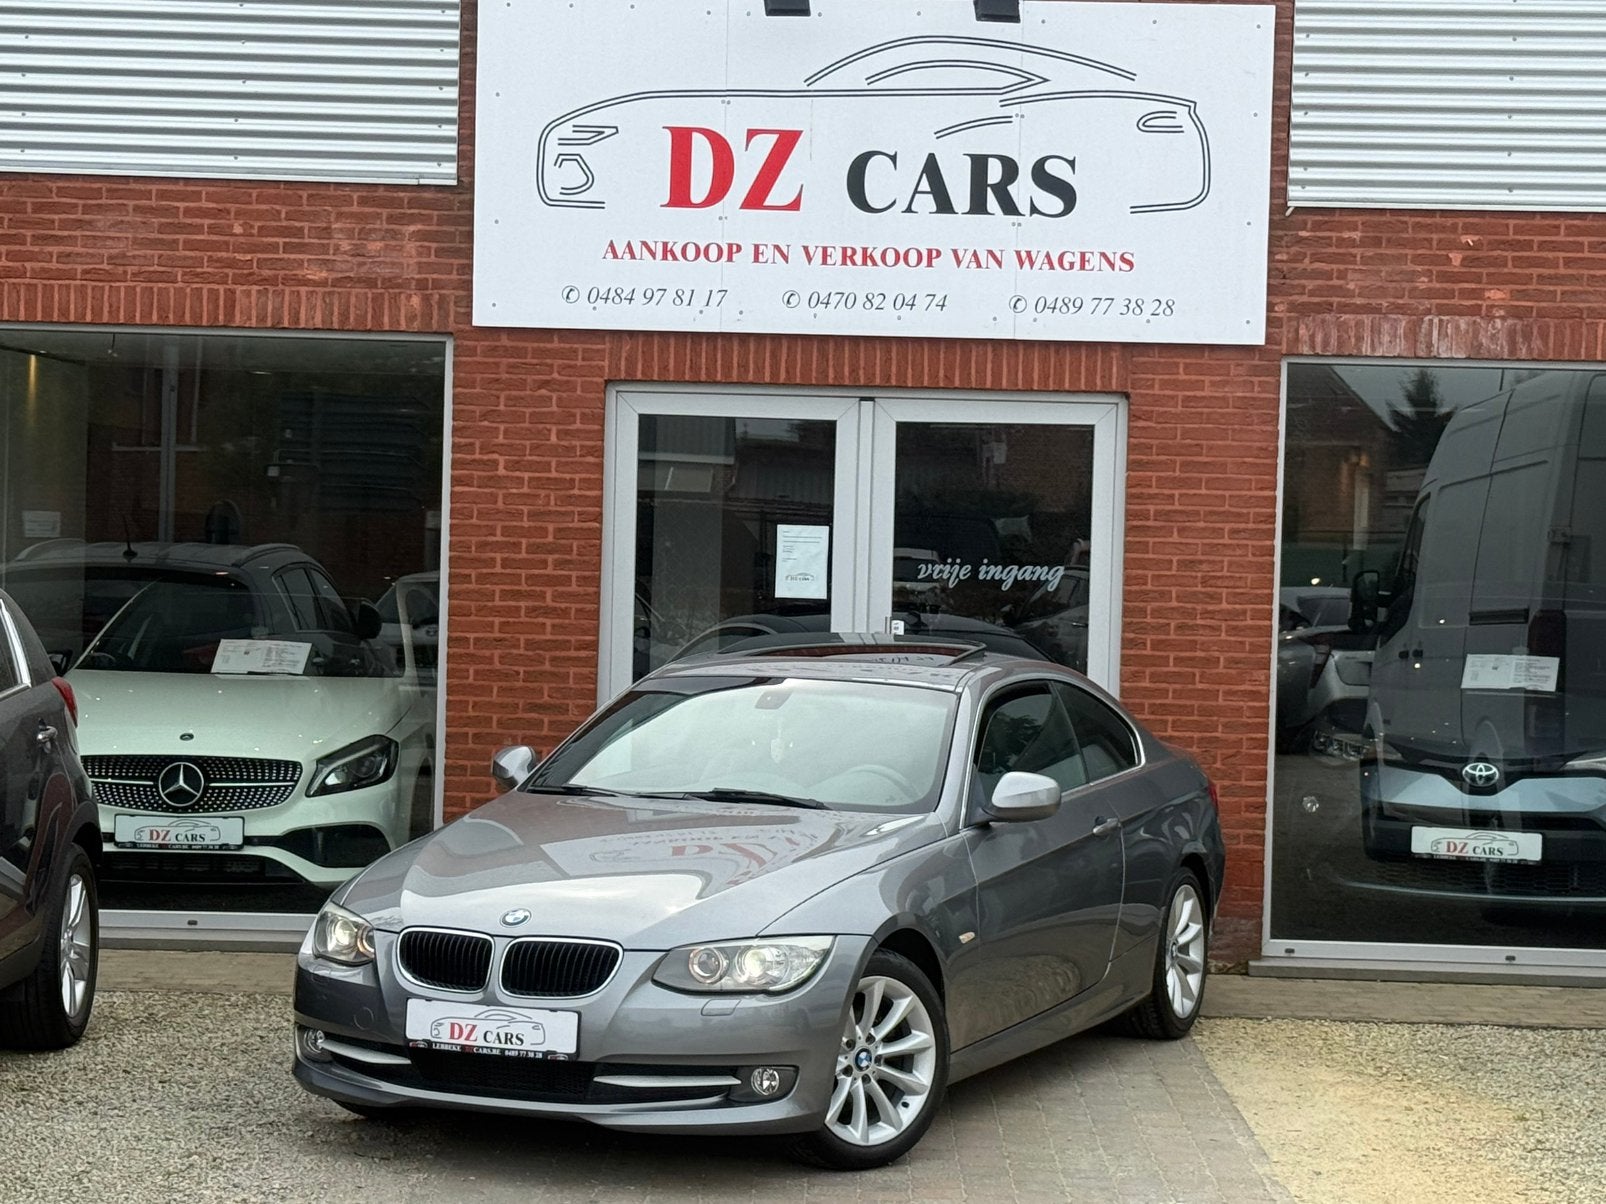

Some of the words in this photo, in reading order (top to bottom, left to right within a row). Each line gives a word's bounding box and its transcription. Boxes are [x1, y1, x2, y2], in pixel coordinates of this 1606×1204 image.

[660, 126, 804, 212] DZ
[846, 150, 1078, 219] CARS
[602, 239, 743, 263] AANKOOP
[751, 243, 791, 265] EN
[801, 245, 942, 268] VERKOOP
[950, 248, 1004, 270] VAN
[1014, 249, 1136, 273] WAGENS
[587, 286, 636, 305] 0484
[642, 287, 667, 306] 97
[672, 288, 696, 307] 81
[702, 289, 728, 308] 17
[807, 291, 857, 310] 0470
[862, 292, 887, 311] 82
[892, 292, 917, 312] 04
[924, 293, 948, 312] 74
[1034, 296, 1084, 315] 0489
[1090, 297, 1115, 316] 77
[1119, 297, 1145, 316] 38
[1150, 298, 1176, 317] 28
[917, 558, 972, 589] vrije
[978, 558, 1066, 592] ingang
[149, 829, 171, 842] DZ
[175, 833, 206, 843] CARS
[1446, 841, 1469, 854] DZ
[1472, 846, 1503, 856] CARS
[449, 1022, 478, 1042] DZ
[483, 1030, 525, 1046] CARS
